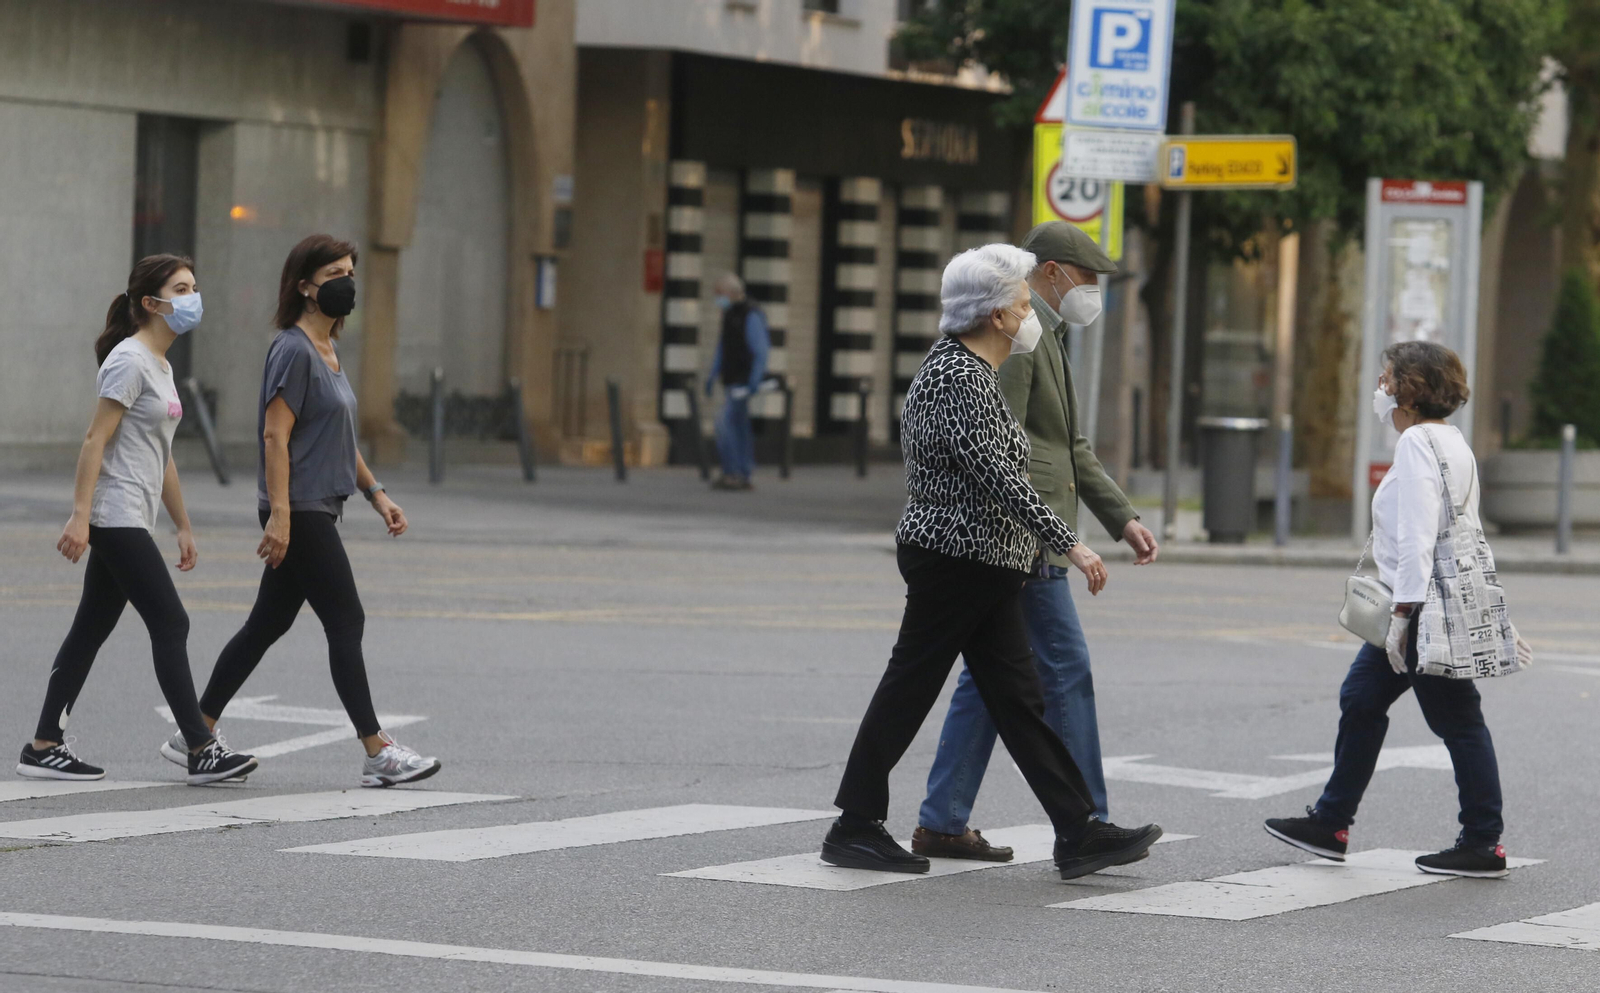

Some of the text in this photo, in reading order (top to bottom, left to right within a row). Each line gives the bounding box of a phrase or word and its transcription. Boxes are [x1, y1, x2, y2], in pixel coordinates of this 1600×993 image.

[1097, 12, 1143, 66] P
[1057, 177, 1100, 201] 20
[1478, 629, 1493, 639] 212
